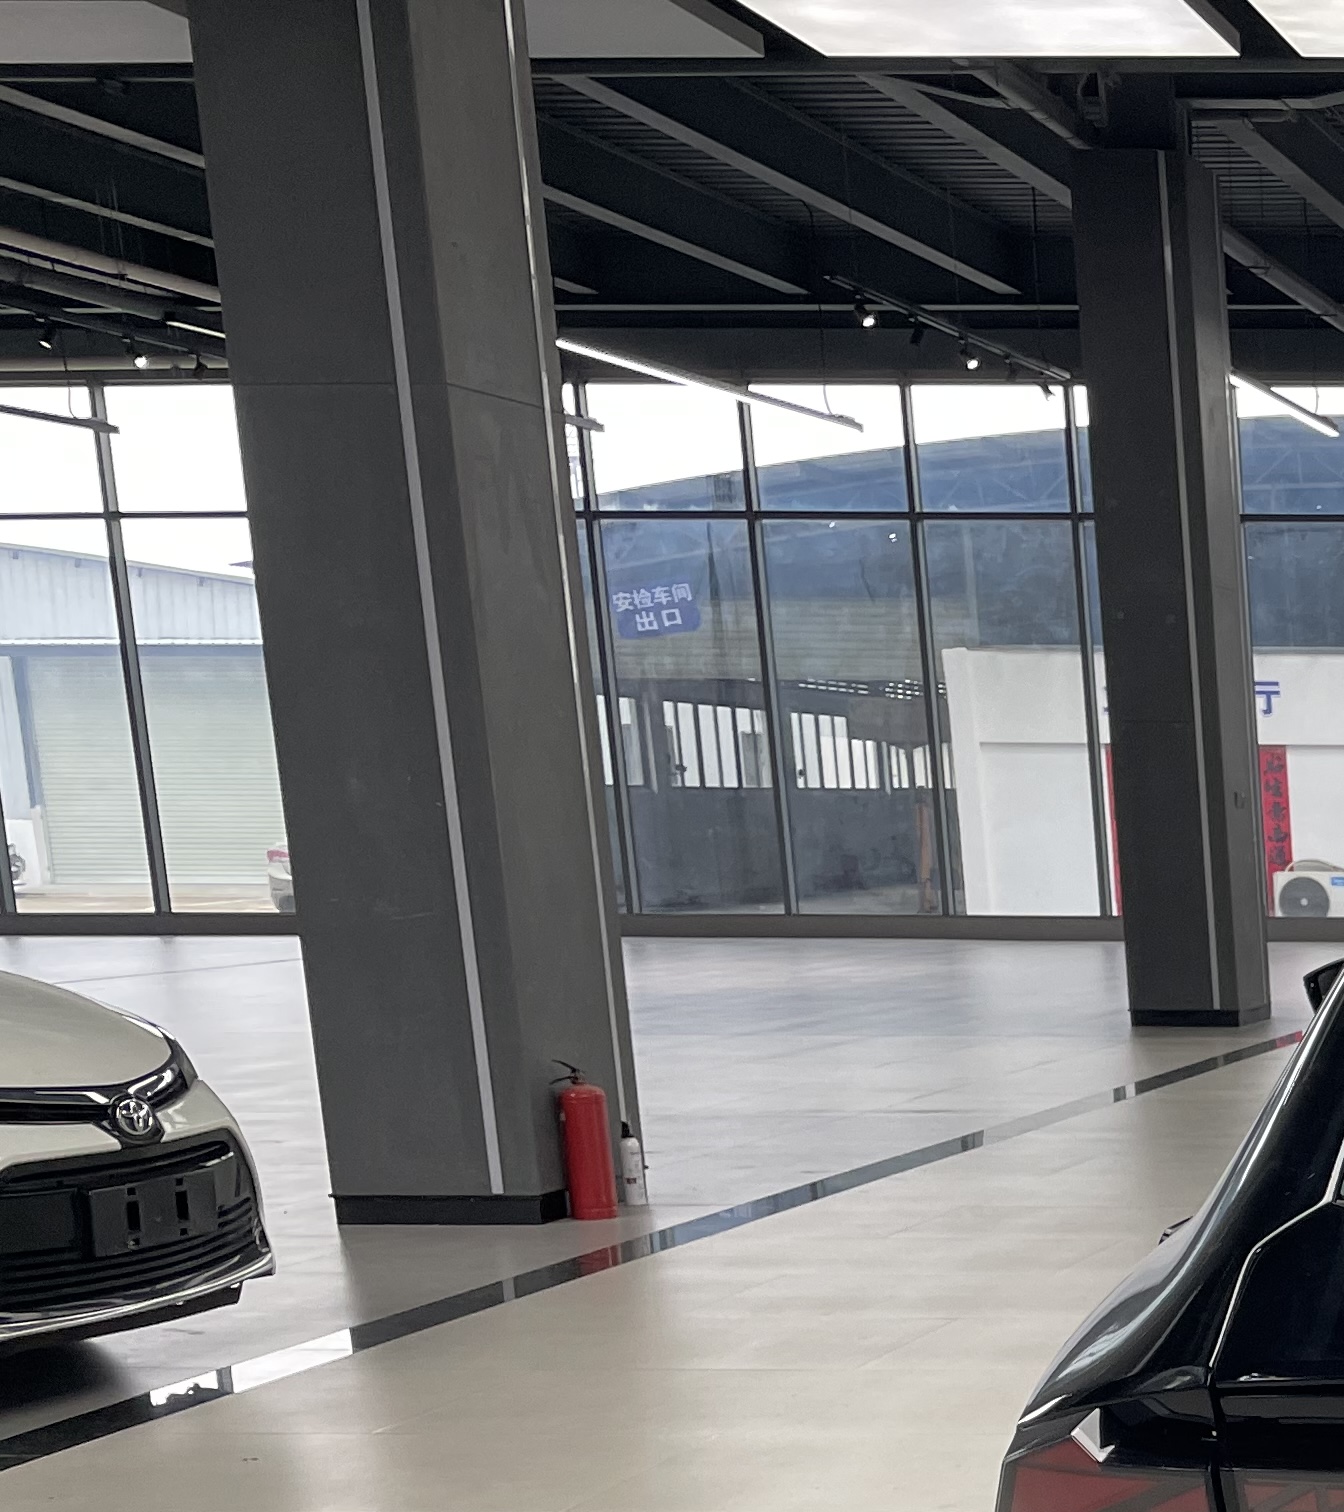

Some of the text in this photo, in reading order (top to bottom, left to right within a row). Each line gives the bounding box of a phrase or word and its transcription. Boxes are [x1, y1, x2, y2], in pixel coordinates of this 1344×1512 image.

[612, 582, 693, 613] 安检车间
[635, 608, 683, 632] 出口
